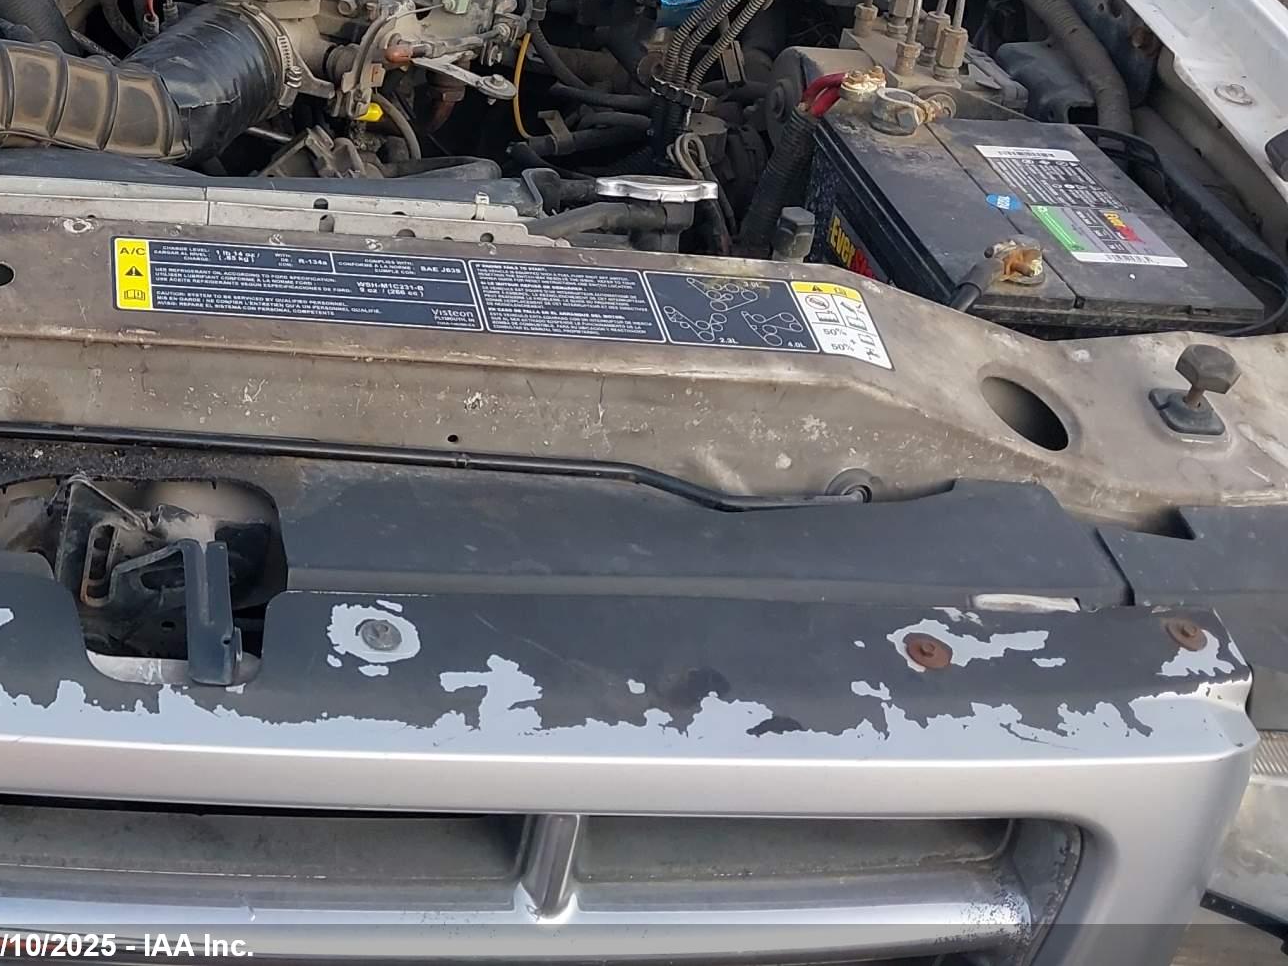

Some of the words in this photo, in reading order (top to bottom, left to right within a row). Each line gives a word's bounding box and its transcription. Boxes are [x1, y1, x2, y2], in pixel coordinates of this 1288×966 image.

[119, 247, 146, 256] A/C
[431, 308, 473, 317] Visteon
[822, 327, 847, 336] 50%
[830, 342, 854, 352] 50%
